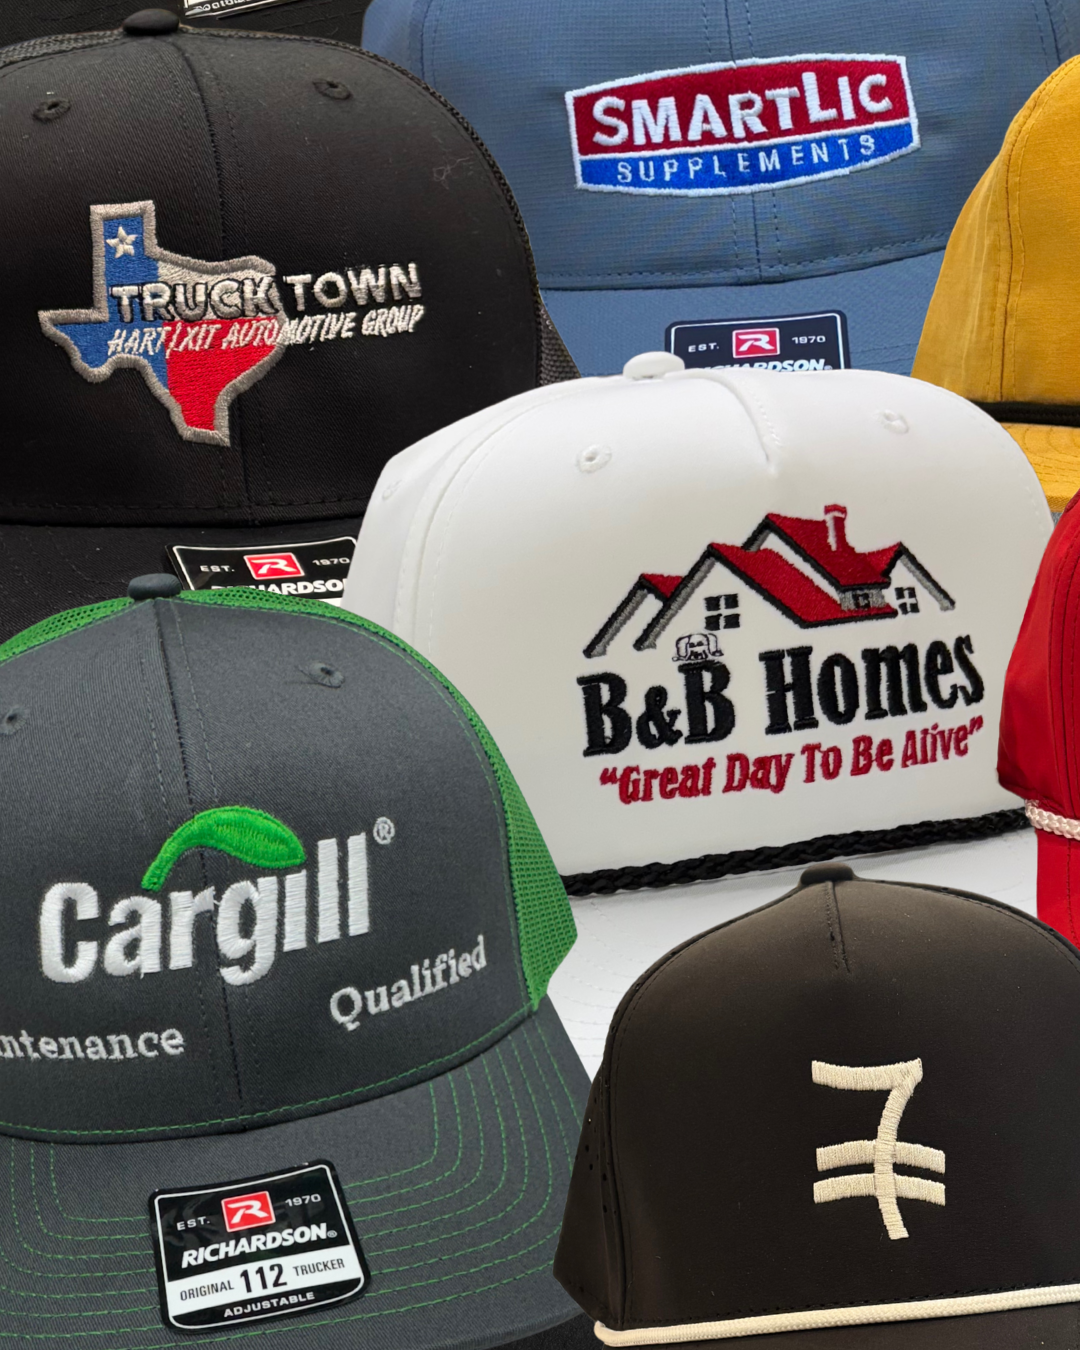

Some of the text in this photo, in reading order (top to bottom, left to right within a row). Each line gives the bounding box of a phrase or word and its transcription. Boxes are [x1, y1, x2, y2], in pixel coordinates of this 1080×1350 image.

[616, 134, 876, 184] SUPPLEMENTS
[109, 262, 422, 324] TRUCK TOWN
[221, 311, 356, 351] AUTOMOTIVE
[362, 304, 424, 337] GROUP
[688, 343, 720, 353] EST.
[792, 335, 826, 344] 1970
[200, 565, 235, 573] EST.
[312, 557, 350, 566] 1970
[576, 634, 986, 758] B&B Homes
[721, 751, 796, 794] Day
[800, 742, 843, 784] To
[850, 734, 895, 777] Be
[330, 935, 488, 1032] Qualified
[177, 1216, 211, 1231] EST.
[285, 1194, 321, 1207] 1970
[180, 1258, 346, 1301] ORIGINAL 112 TRUCKER
[223, 1291, 316, 1318] ADJUSTABLE
